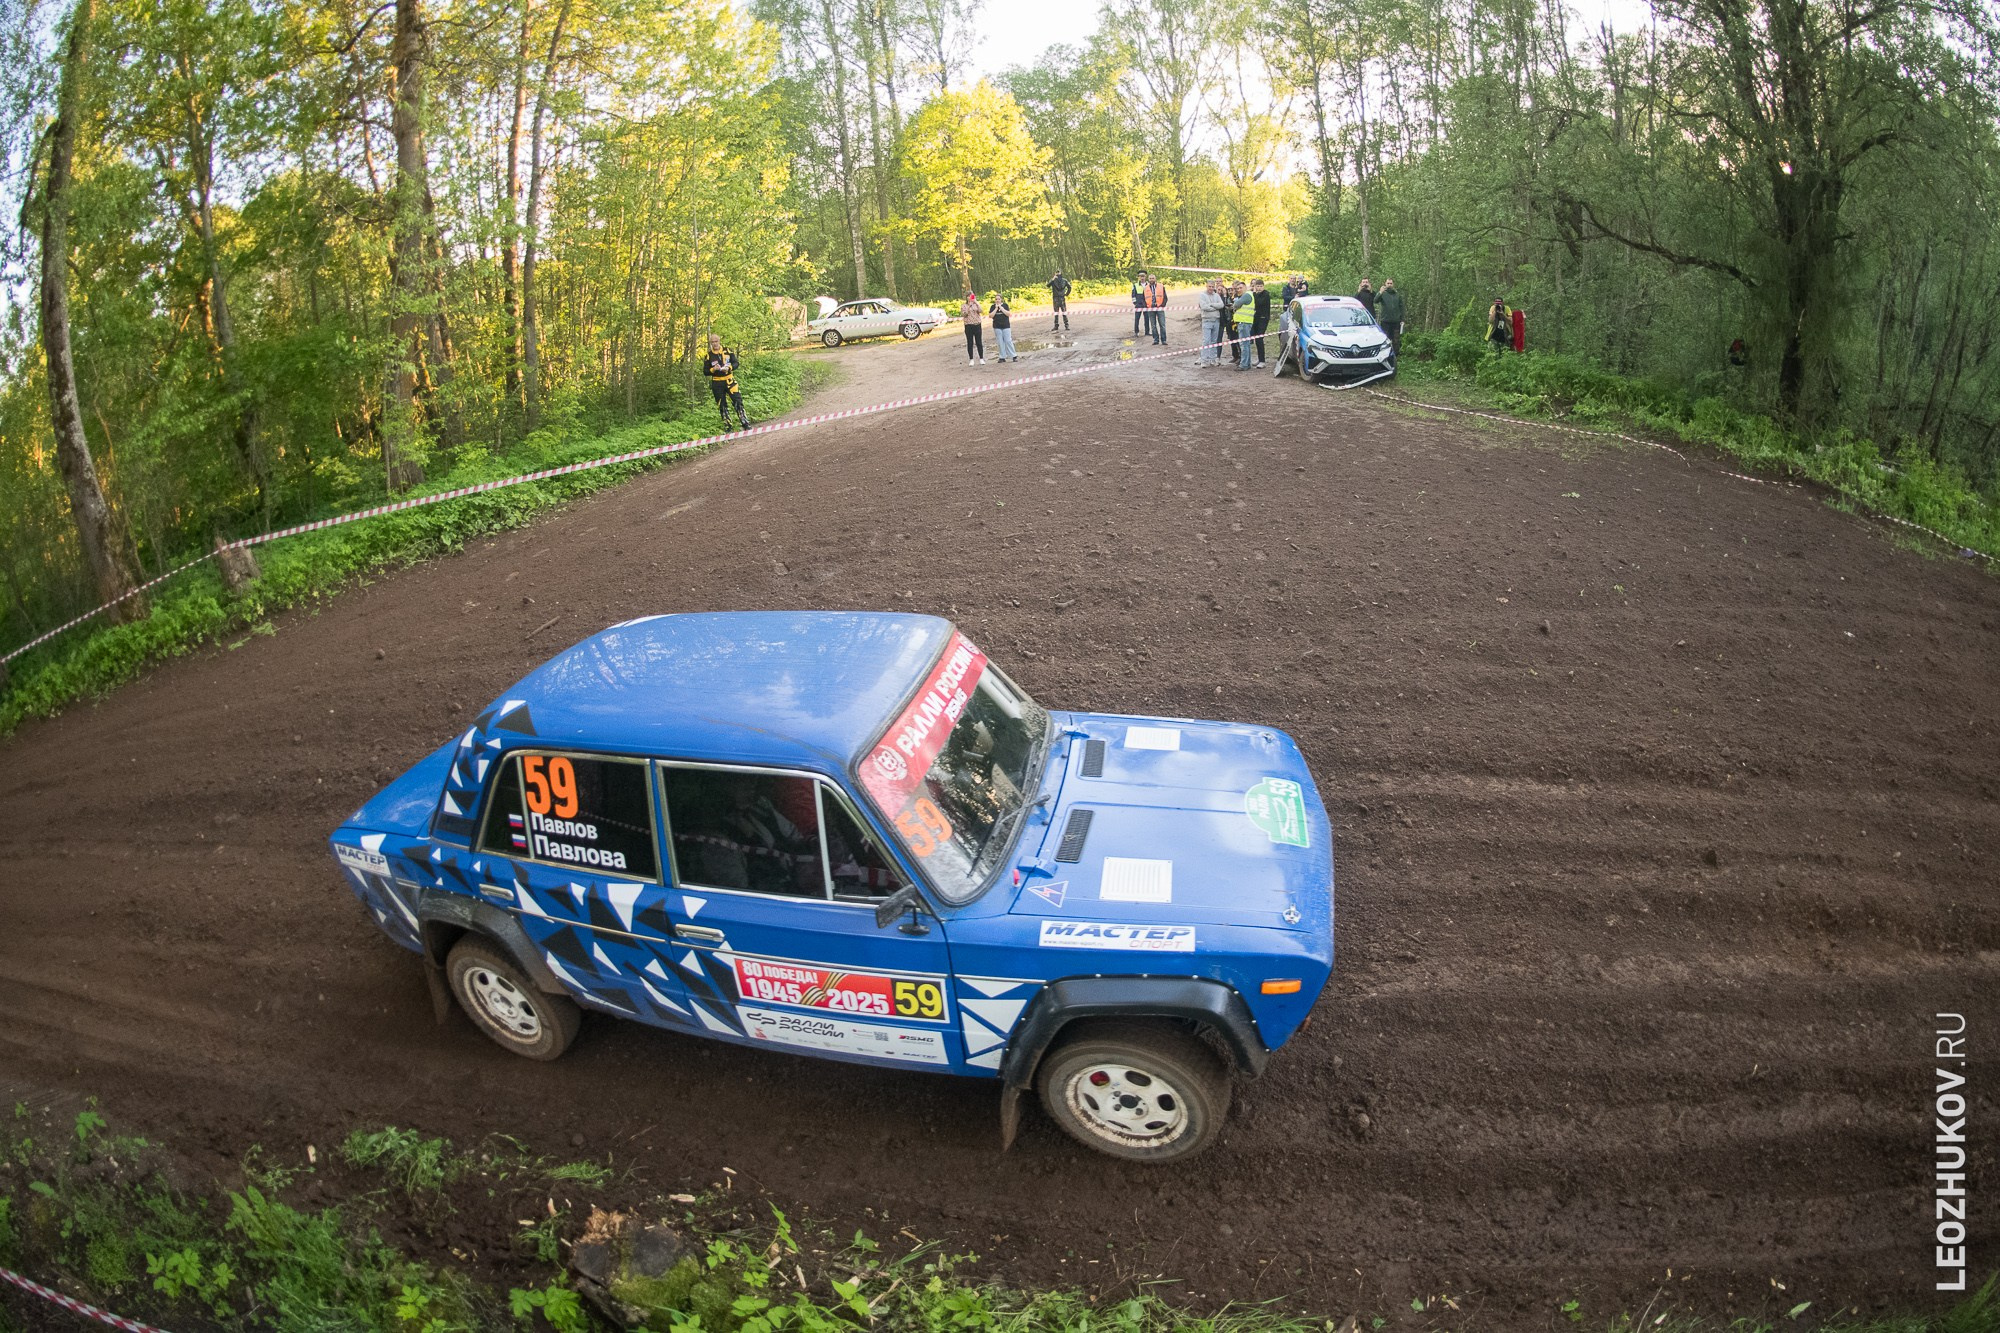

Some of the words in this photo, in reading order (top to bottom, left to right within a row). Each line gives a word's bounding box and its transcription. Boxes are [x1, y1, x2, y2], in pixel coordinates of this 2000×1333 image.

[896, 691, 946, 758] РАЛЛИ
[935, 645, 974, 699] РОССИИ
[523, 755, 579, 819] 59
[1269, 779, 1298, 798] 59
[530, 812, 599, 840] Павлов
[895, 797, 952, 858] 59
[337, 846, 386, 865] МАСТЕР
[534, 834, 628, 869] Павлова
[1044, 922, 1192, 941] МАСТЕР
[1129, 940, 1185, 950] СПОРТ
[741, 960, 763, 978] 80
[763, 965, 819, 985] ПОБЕДА!
[746, 977, 804, 1004] 1945
[826, 988, 890, 1016] 2025
[894, 981, 944, 1018] 59
[779, 1023, 845, 1039] РОССИИ
[780, 1016, 835, 1031] РАЛЛИ
